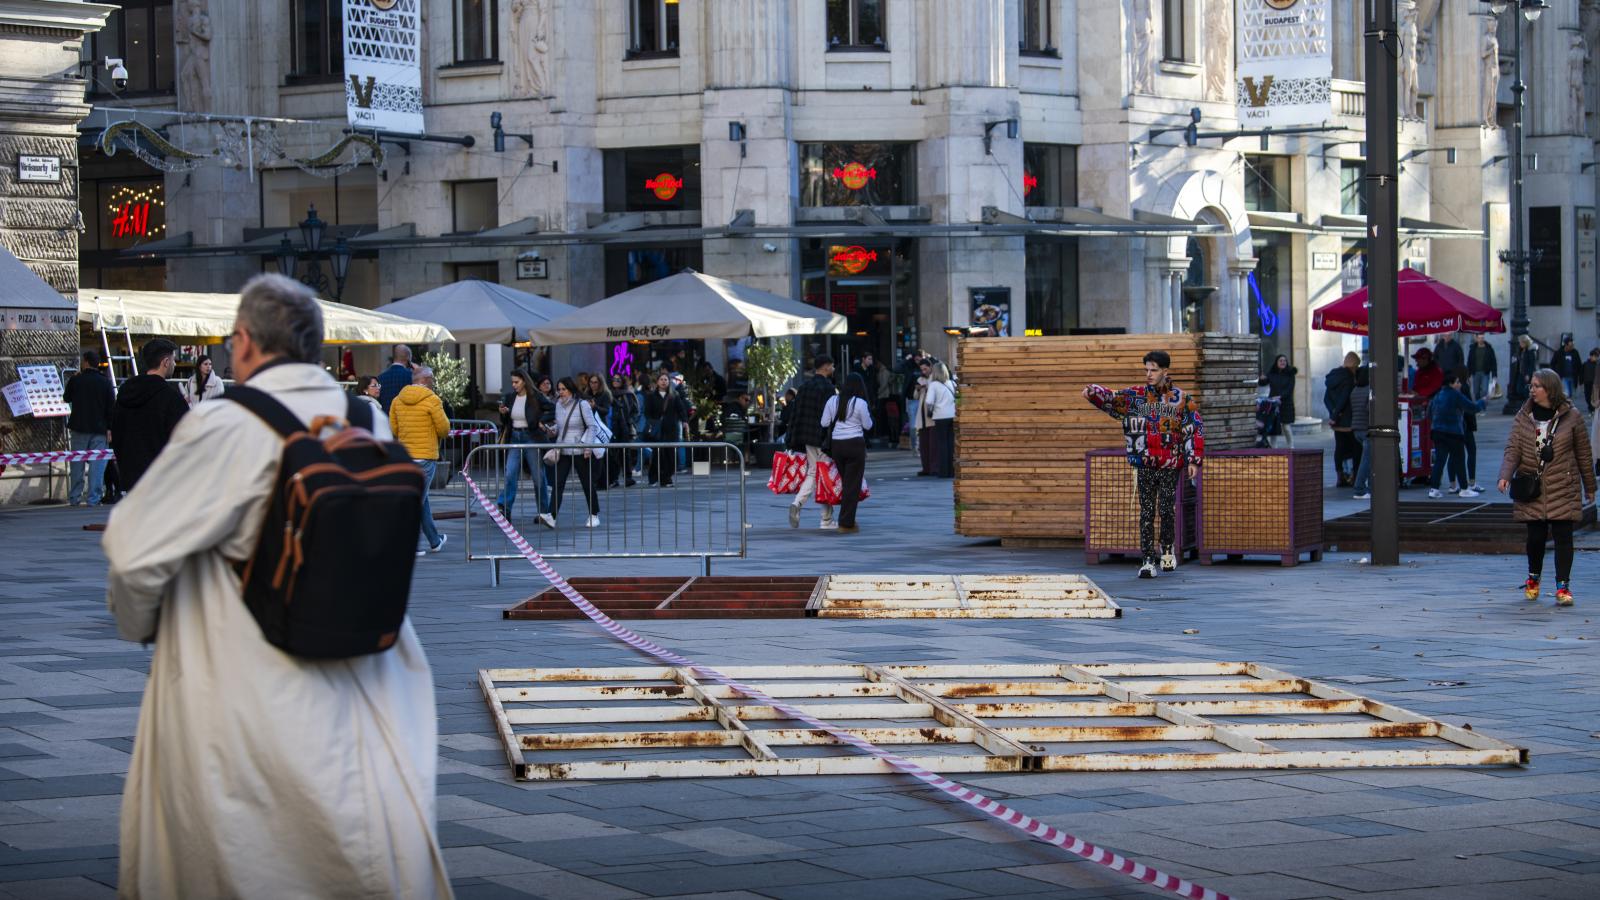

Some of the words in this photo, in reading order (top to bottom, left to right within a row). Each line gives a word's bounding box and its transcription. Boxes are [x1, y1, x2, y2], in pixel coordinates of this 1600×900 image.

[369, 16, 398, 27] BUDAPEST
[1264, 15, 1300, 25] BUDAPEST
[112, 201, 149, 238] H&M
[18, 314, 37, 323] PIZZA
[49, 315, 74, 324] SALADS
[1406, 322, 1418, 330] On
[1426, 320, 1441, 329] Hop
[1442, 318, 1454, 326] Off
[607, 326, 628, 337] Hard
[629, 326, 650, 338] Rock
[651, 325, 671, 337] Cafe
[1130, 417, 1146, 433] 07
